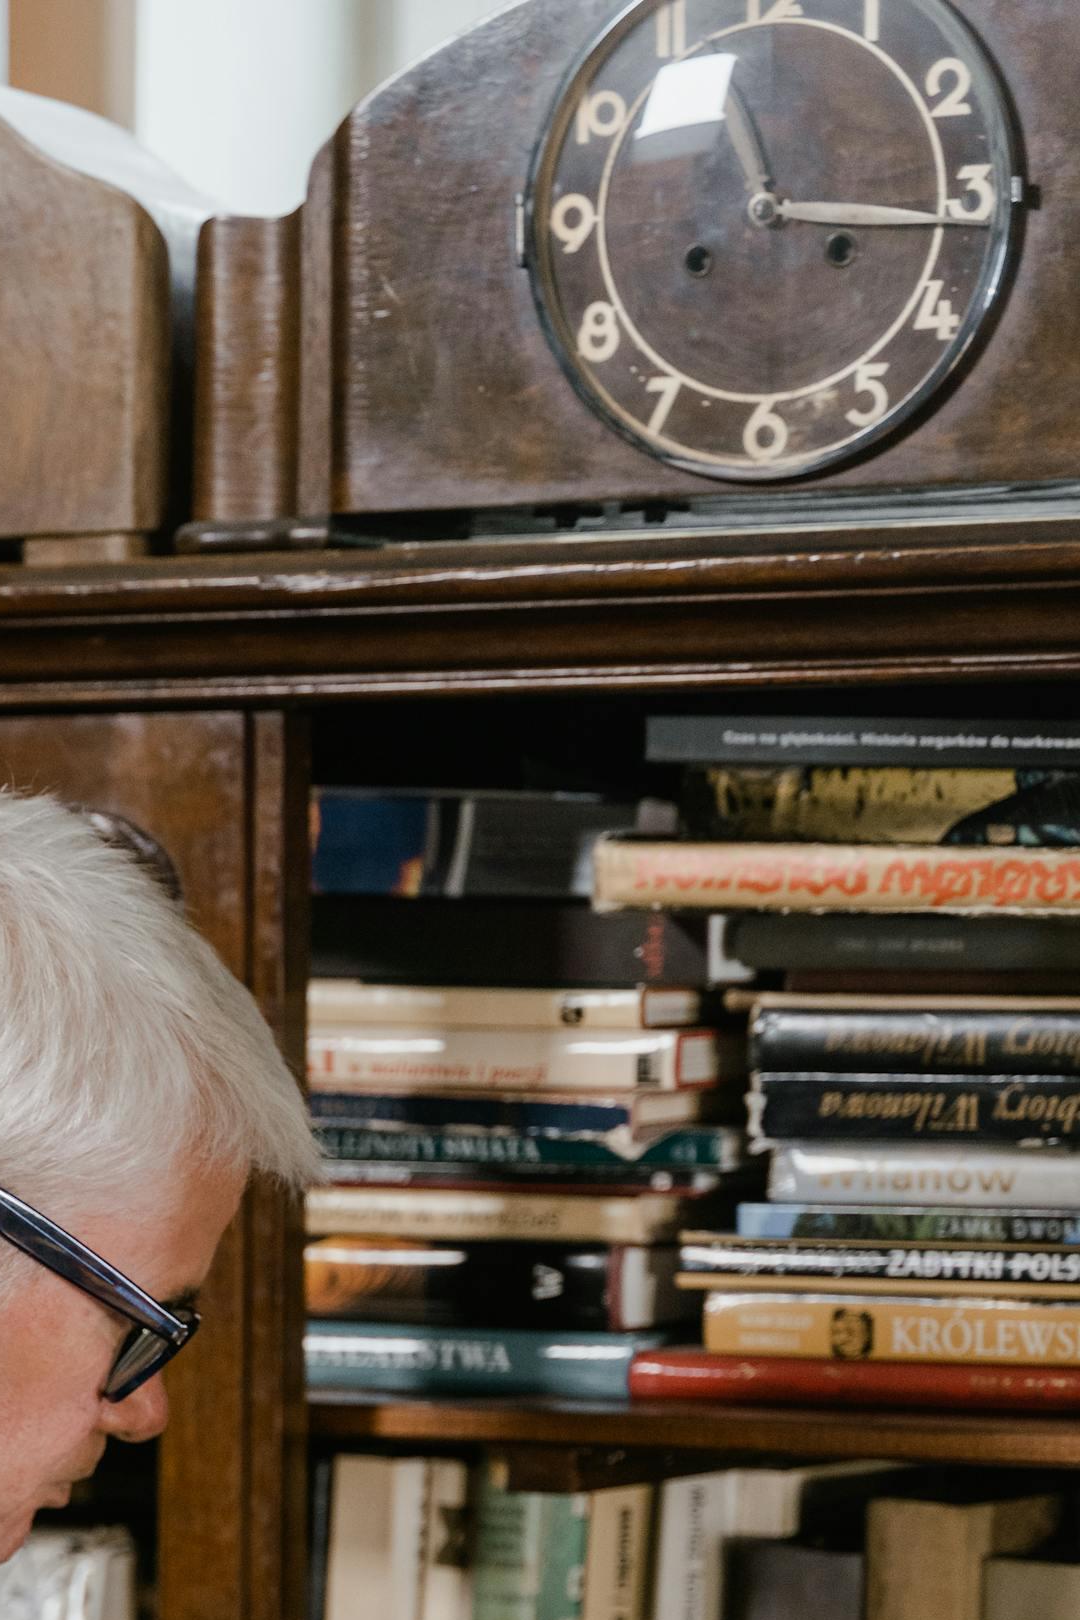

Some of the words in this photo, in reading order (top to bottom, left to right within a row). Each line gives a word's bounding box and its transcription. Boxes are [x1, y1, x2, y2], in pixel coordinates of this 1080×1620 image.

[924, 57, 972, 118] 2
[576, 91, 624, 144] 10
[944, 163, 994, 222] 3
[550, 194, 595, 253] 9
[577, 301, 620, 363] 8
[914, 279, 961, 340] 4
[645, 377, 681, 436] 7
[845, 362, 890, 428] 5
[742, 400, 788, 461] 6
[816, 1090, 981, 1133] Wilanowa
[886, 1249, 1004, 1279] ZABYTKI
[891, 1312, 1080, 1359] KRÓLEWS
